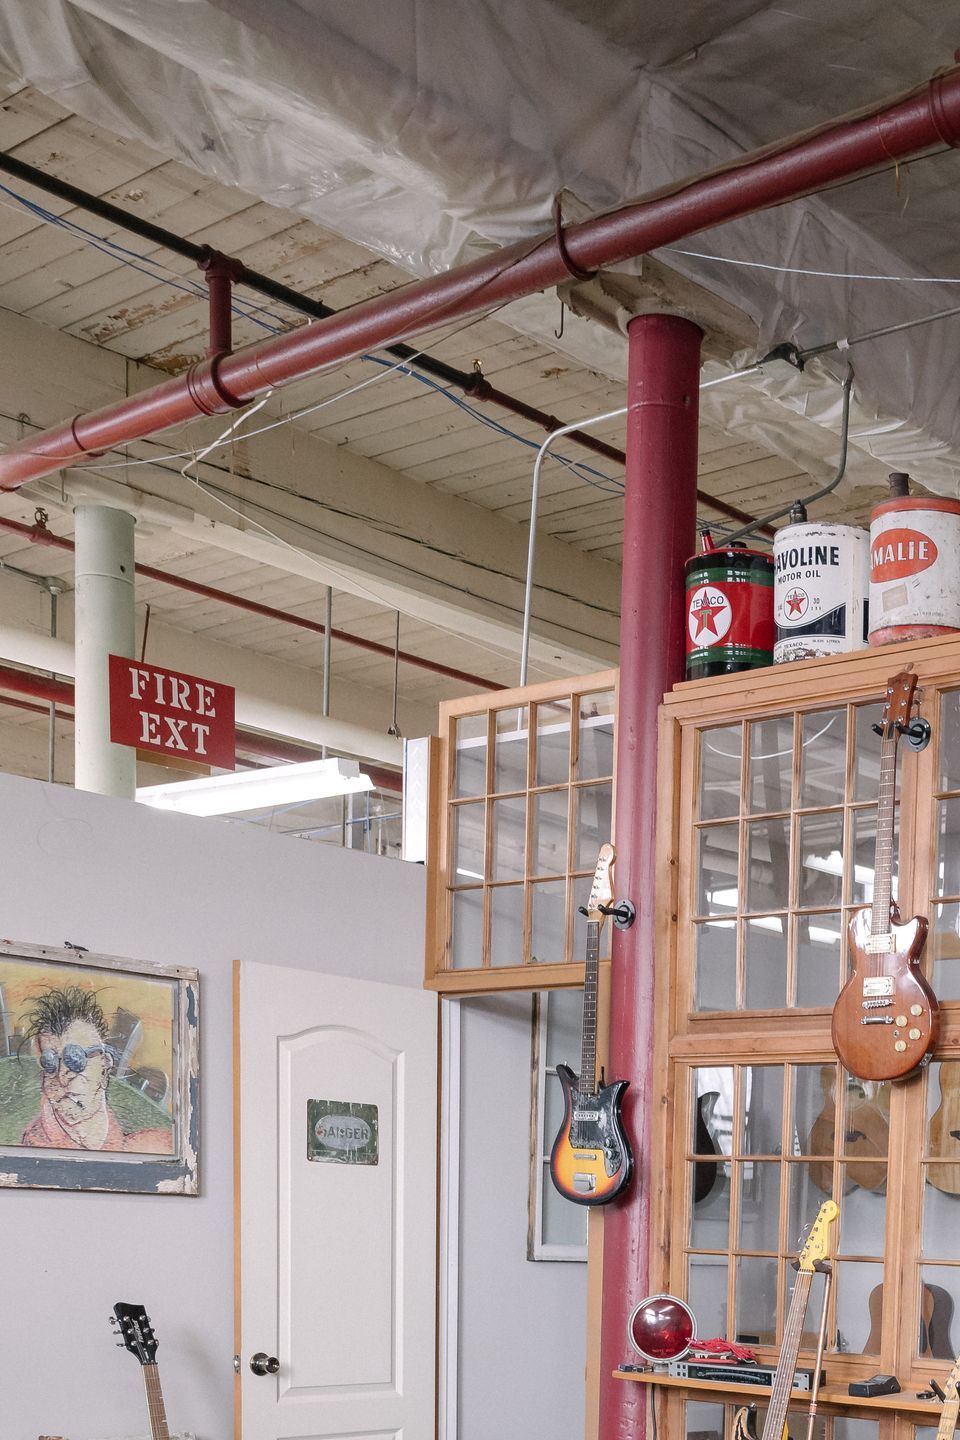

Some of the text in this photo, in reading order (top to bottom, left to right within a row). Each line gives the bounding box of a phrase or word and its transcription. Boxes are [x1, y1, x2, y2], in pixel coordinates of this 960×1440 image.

[776, 546, 839, 572] AVOLINE
[871, 541, 929, 569] MALIE
[778, 570, 821, 584] MOTOR OIL
[693, 596, 724, 609] TEXACO
[129, 667, 216, 718] FIRE
[139, 710, 210, 755] EXT
